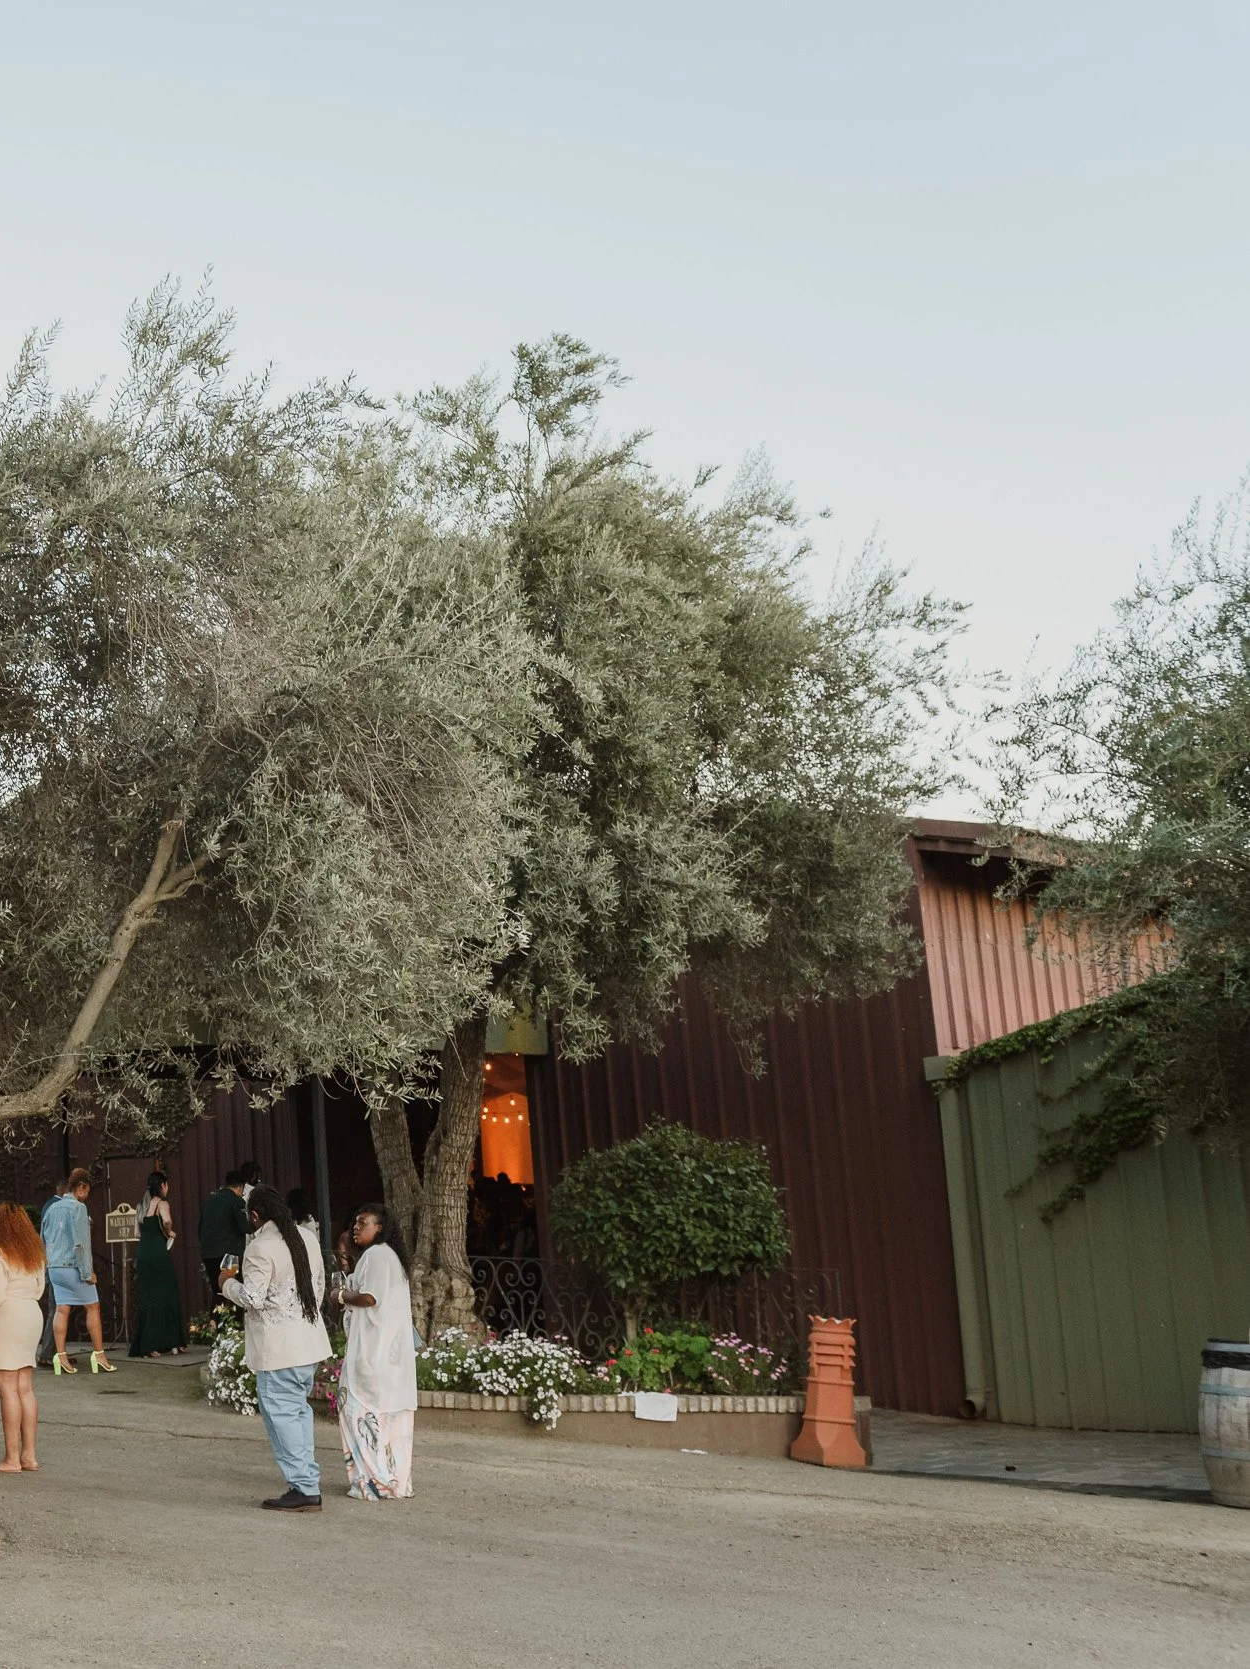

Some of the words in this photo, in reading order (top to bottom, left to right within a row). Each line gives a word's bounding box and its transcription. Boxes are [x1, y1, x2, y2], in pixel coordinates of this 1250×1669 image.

[110, 1217, 125, 1227] WATCH
[125, 1216, 135, 1226] YOU
[118, 1227, 130, 1238] STEP
